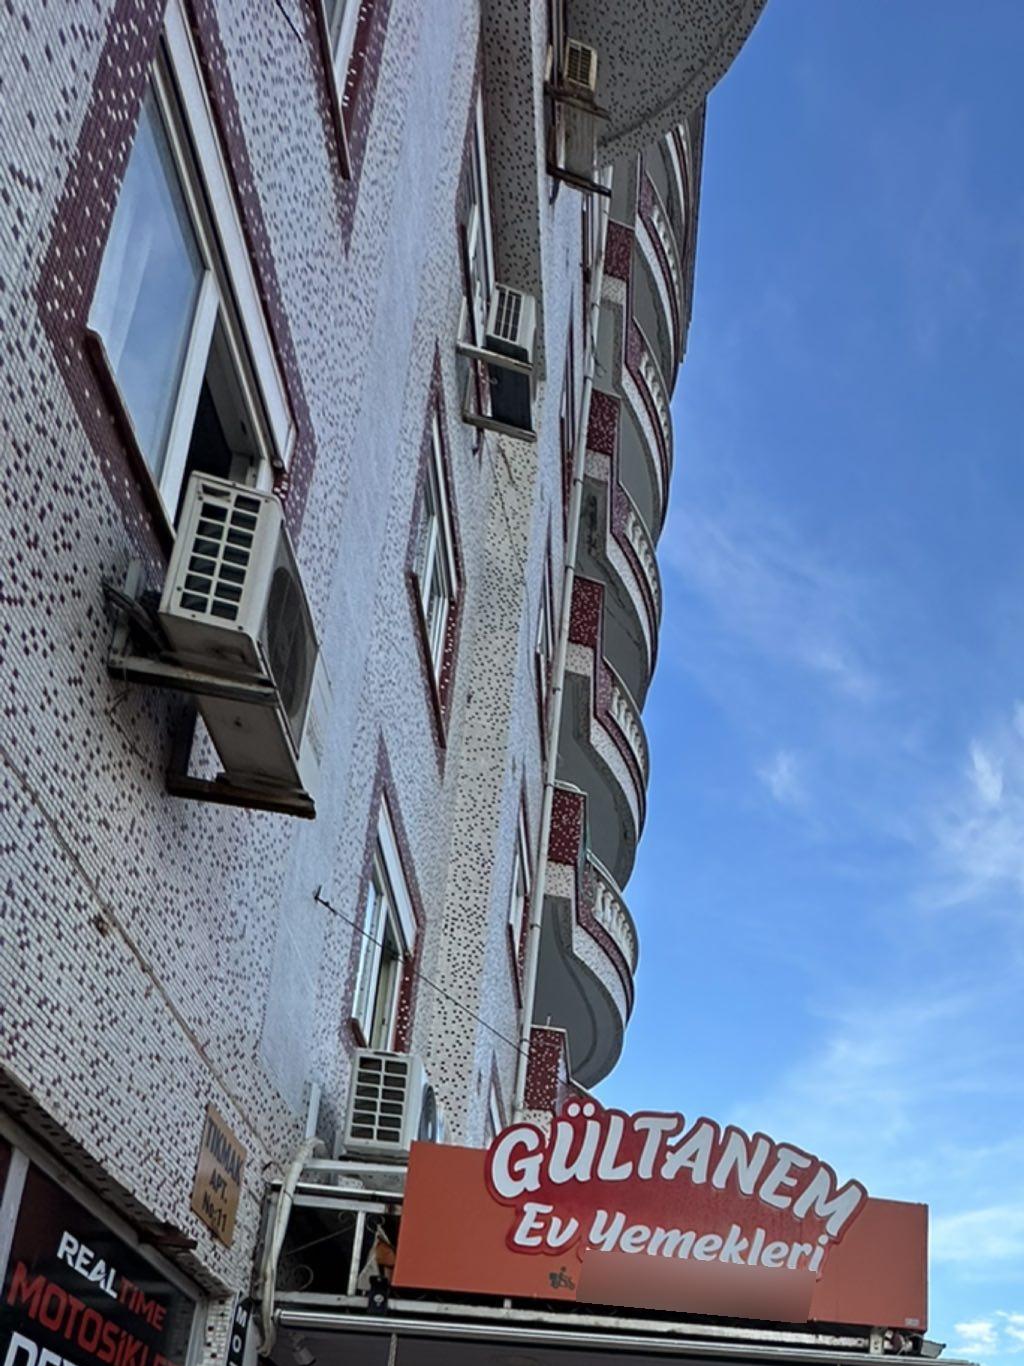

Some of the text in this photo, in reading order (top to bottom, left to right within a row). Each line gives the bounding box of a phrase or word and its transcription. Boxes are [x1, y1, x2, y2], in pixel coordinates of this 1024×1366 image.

[490, 1102, 868, 1238] GÜLTANEM
[513, 1202, 827, 1273] Ev Yemekleri
